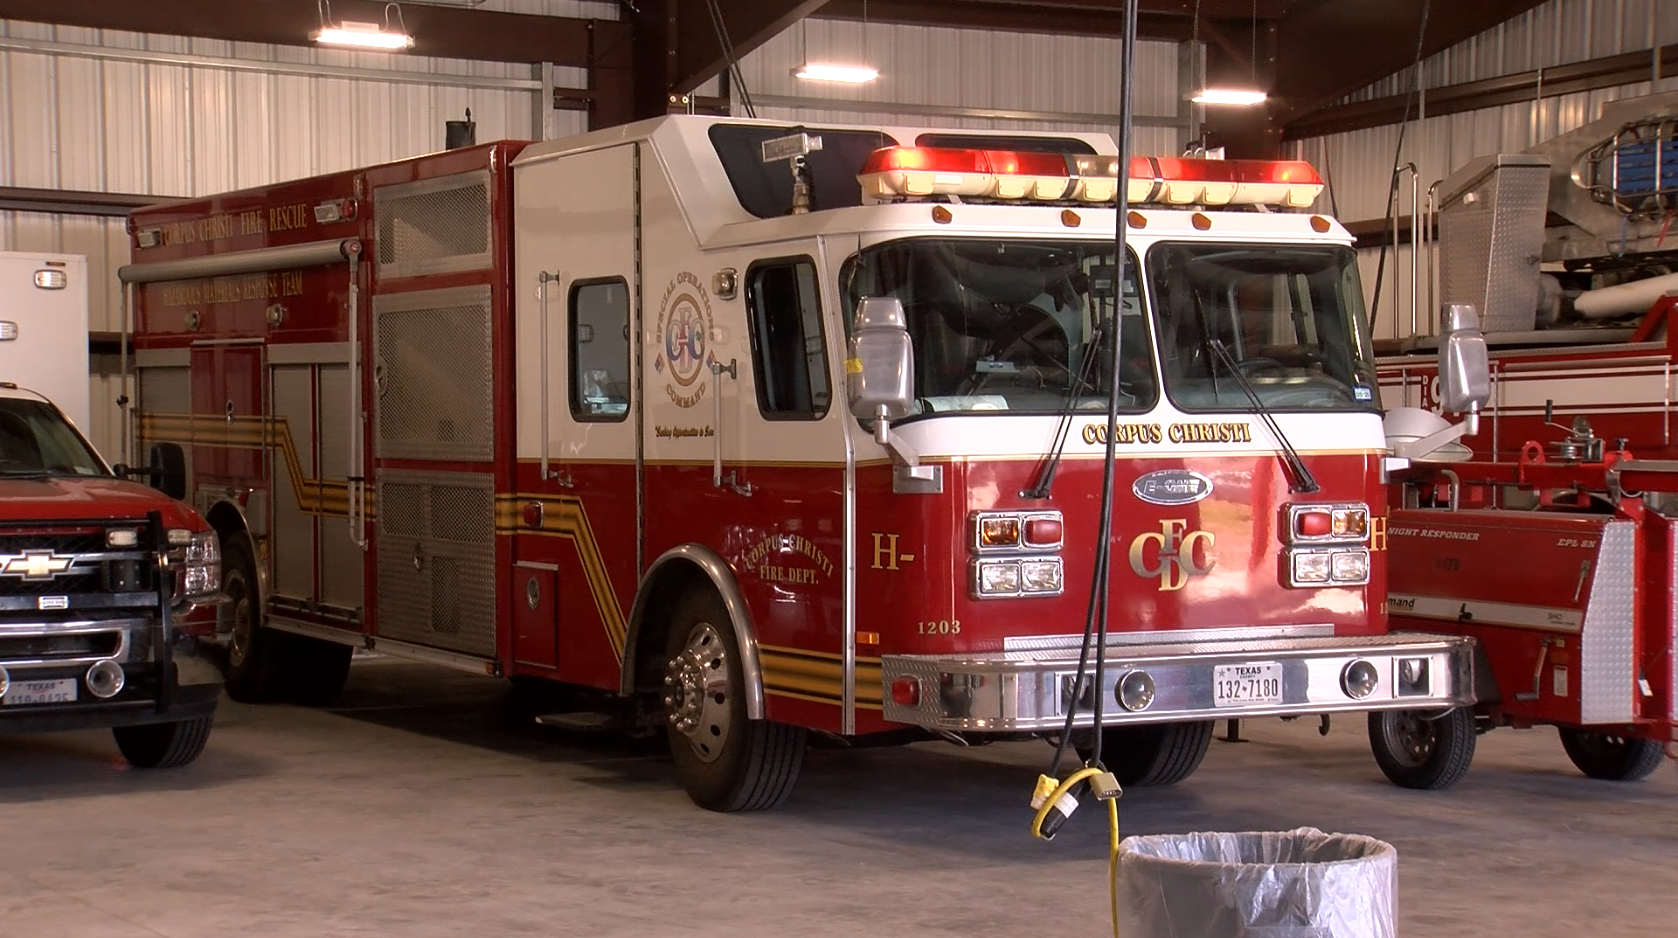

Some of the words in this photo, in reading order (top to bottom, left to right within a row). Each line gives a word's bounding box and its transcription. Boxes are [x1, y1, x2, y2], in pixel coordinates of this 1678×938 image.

[163, 221, 195, 247] CORPUS
[200, 213, 233, 241] CHRISTI
[240, 210, 262, 235] FIRE
[270, 204, 307, 231] RESCUE
[282, 271, 302, 296] TEAM
[657, 279, 676, 343] SPECIAL
[677, 272, 714, 341] OPERATIONS
[666, 382, 706, 408] COMMAND
[1082, 423, 1163, 445] CORPUS
[1168, 422, 1252, 444] CHRISTI
[1387, 527, 1419, 536] NIGHT
[1420, 529, 1480, 541] RESPONDER
[1556, 538, 1578, 547] EPL
[1580, 540, 1597, 548] SN
[745, 533, 784, 569] CORPUS
[788, 533, 834, 577] CHRISTI
[760, 565, 784, 580] FIRE
[788, 567, 819, 584] DEPT.
[1388, 598, 1415, 608] mand
[918, 620, 961, 634] 1203
[1235, 667, 1262, 675] TEXAS
[27, 682, 56, 690] TEXAS
